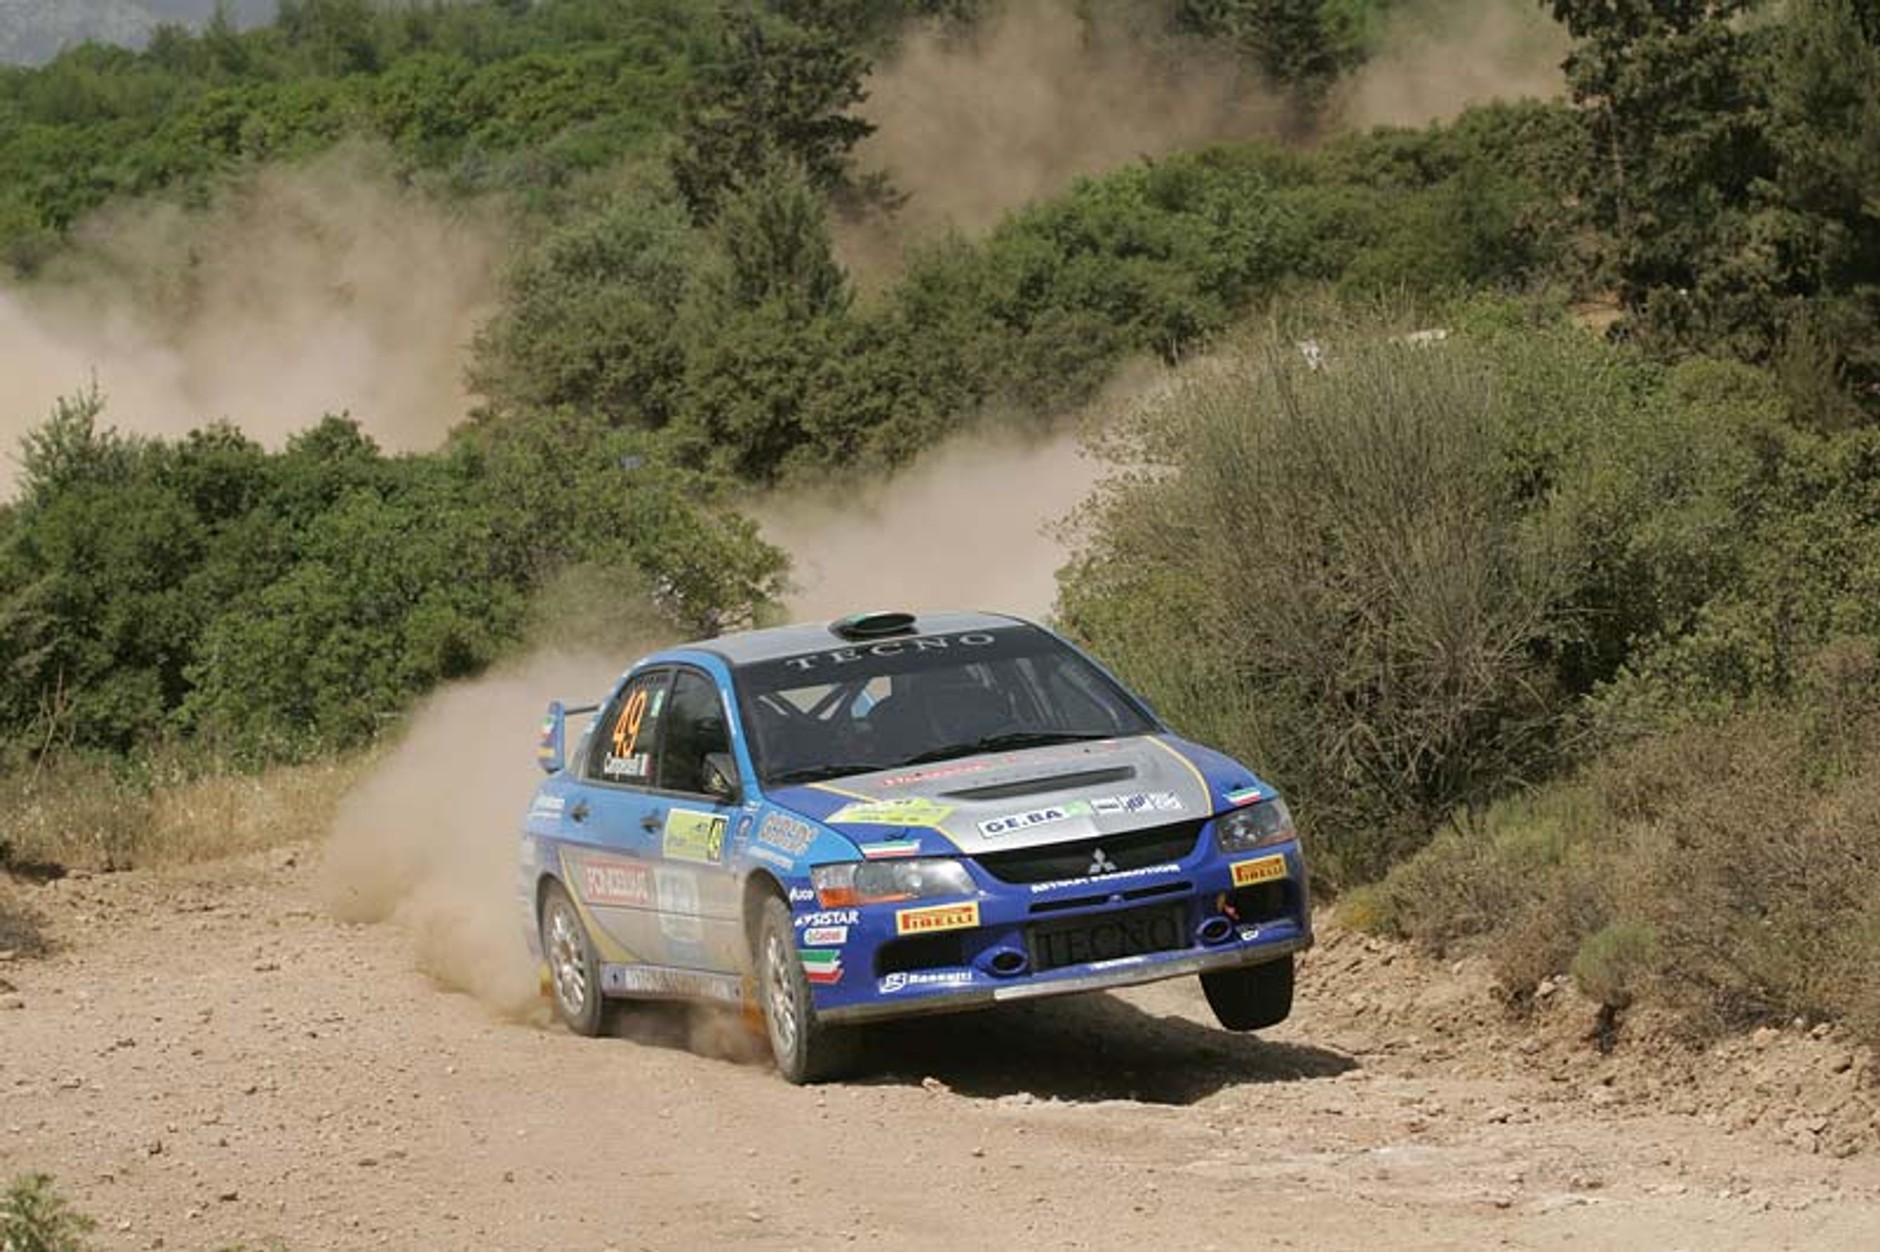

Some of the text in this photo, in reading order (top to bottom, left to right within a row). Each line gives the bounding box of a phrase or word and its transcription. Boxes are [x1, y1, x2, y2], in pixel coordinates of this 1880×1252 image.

[786, 634, 995, 670] TECNO
[612, 688, 648, 759] 49
[986, 809, 1063, 833] GE.BA
[1236, 858, 1282, 881] PIRELLI
[902, 906, 973, 930] PIRELLI
[1036, 914, 1179, 968] TECNO
